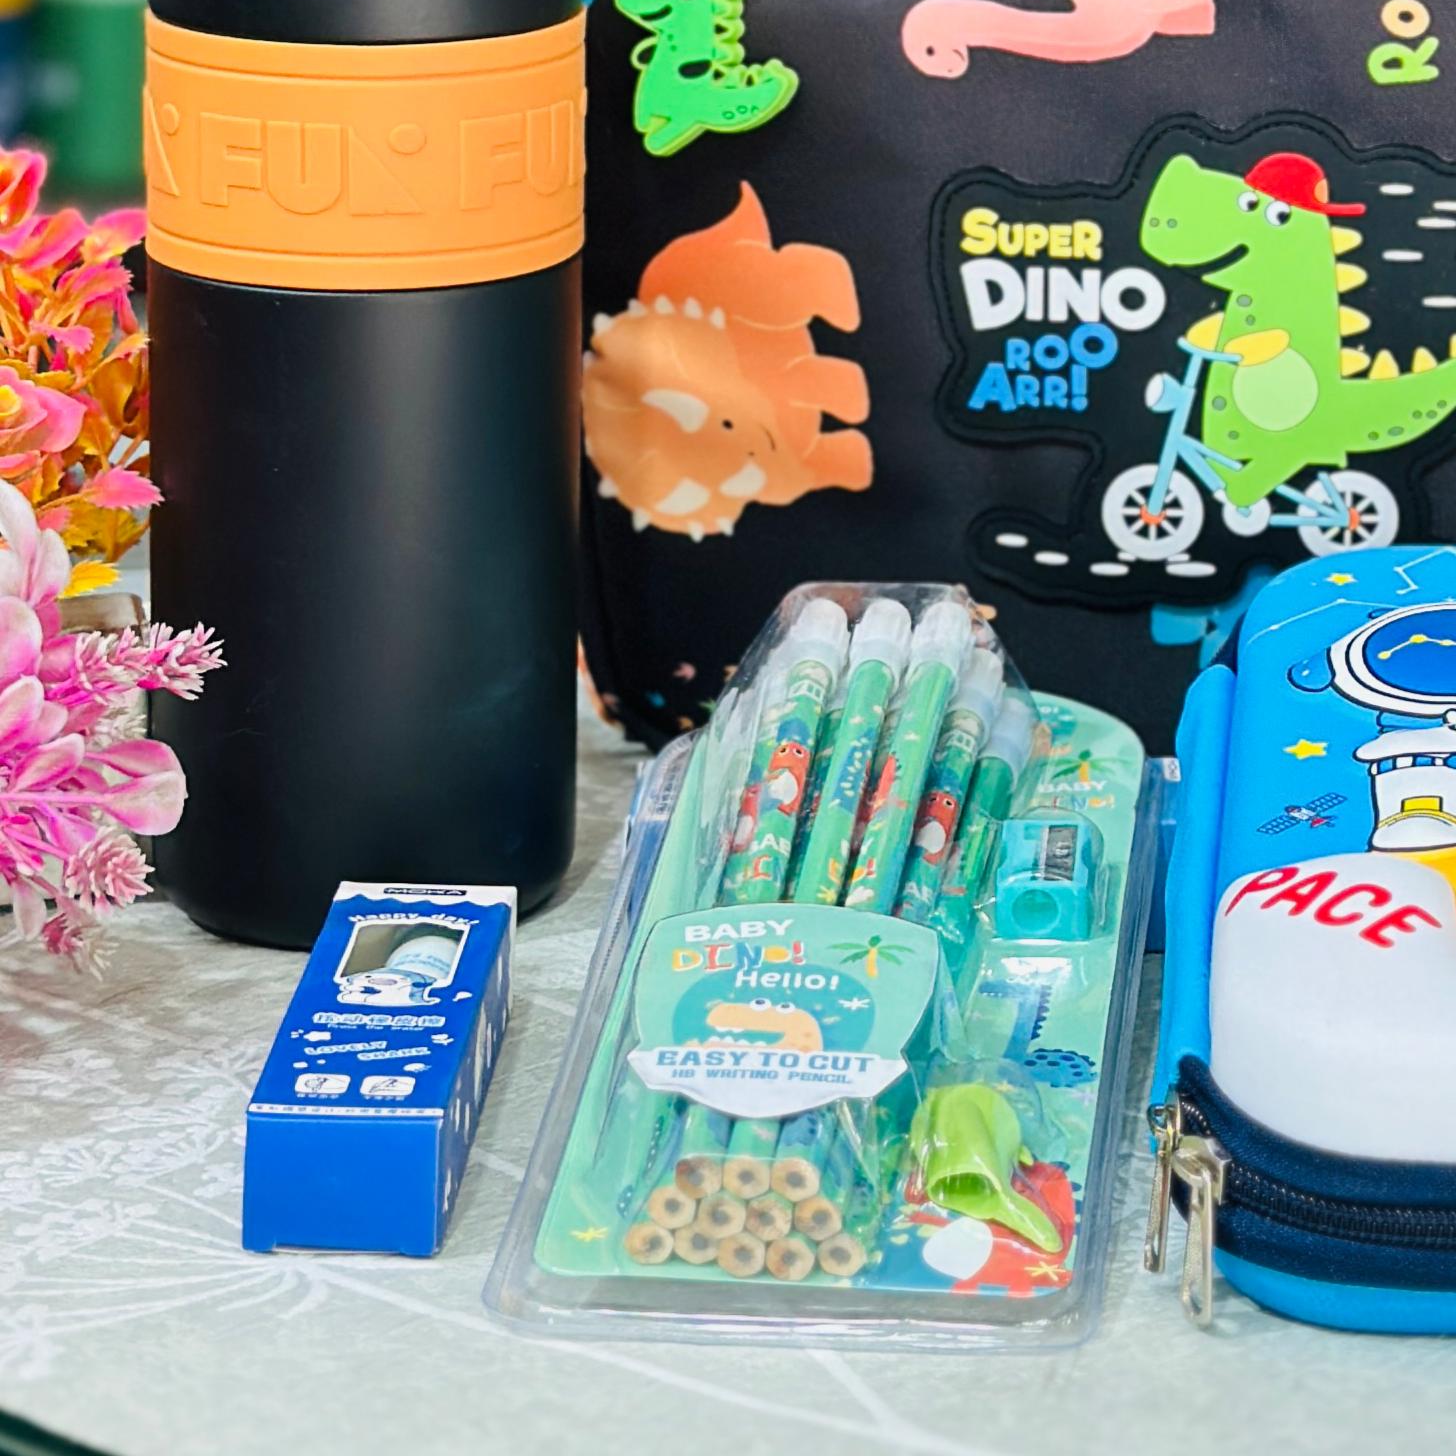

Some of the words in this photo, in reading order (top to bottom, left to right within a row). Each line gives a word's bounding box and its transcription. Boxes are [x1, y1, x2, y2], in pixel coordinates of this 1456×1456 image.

[960, 208, 1102, 261] SUPER
[960, 259, 1165, 332] DINO
[1006, 323, 1118, 371] ROO
[967, 361, 1088, 411] ARR!
[1225, 866, 1442, 950] PACE
[685, 918, 794, 942] BABY
[672, 940, 806, 971] DINO!
[735, 971, 839, 990] Hello!
[656, 1050, 748, 1067] EASY
[758, 1052, 799, 1068] TO
[808, 1054, 875, 1073] CUT
[672, 1069, 695, 1078] HB
[707, 1069, 779, 1080] WRITING
